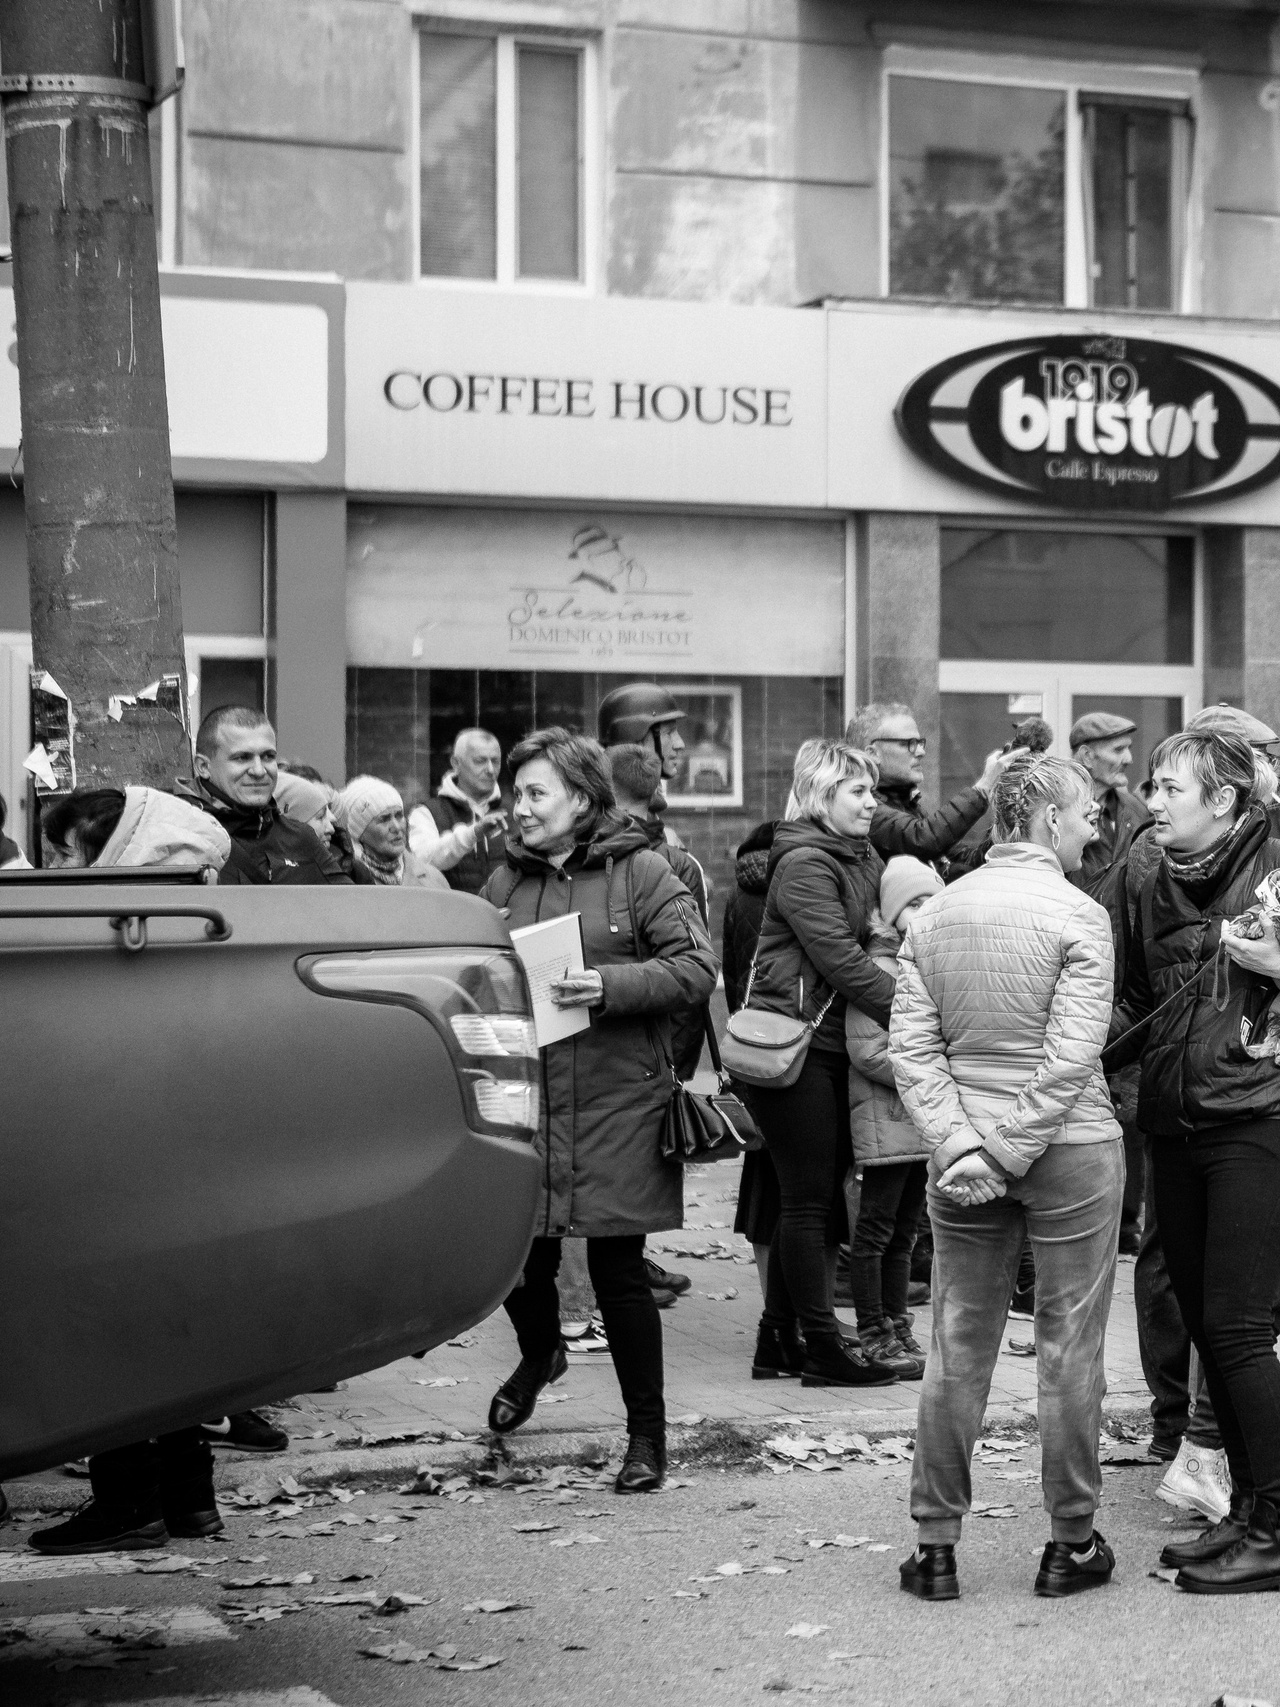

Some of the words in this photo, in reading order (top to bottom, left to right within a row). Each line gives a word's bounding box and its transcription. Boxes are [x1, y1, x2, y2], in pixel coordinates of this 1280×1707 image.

[383, 369, 596, 418] COFFEE
[609, 381, 793, 427] HOUSE
[1040, 357, 1139, 404] 1919
[1001, 375, 1220, 460] bristot
[1091, 460, 1160, 487] Espresso
[509, 626, 613, 645] DOMENICO
[618, 628, 691, 646] BRISTOT
